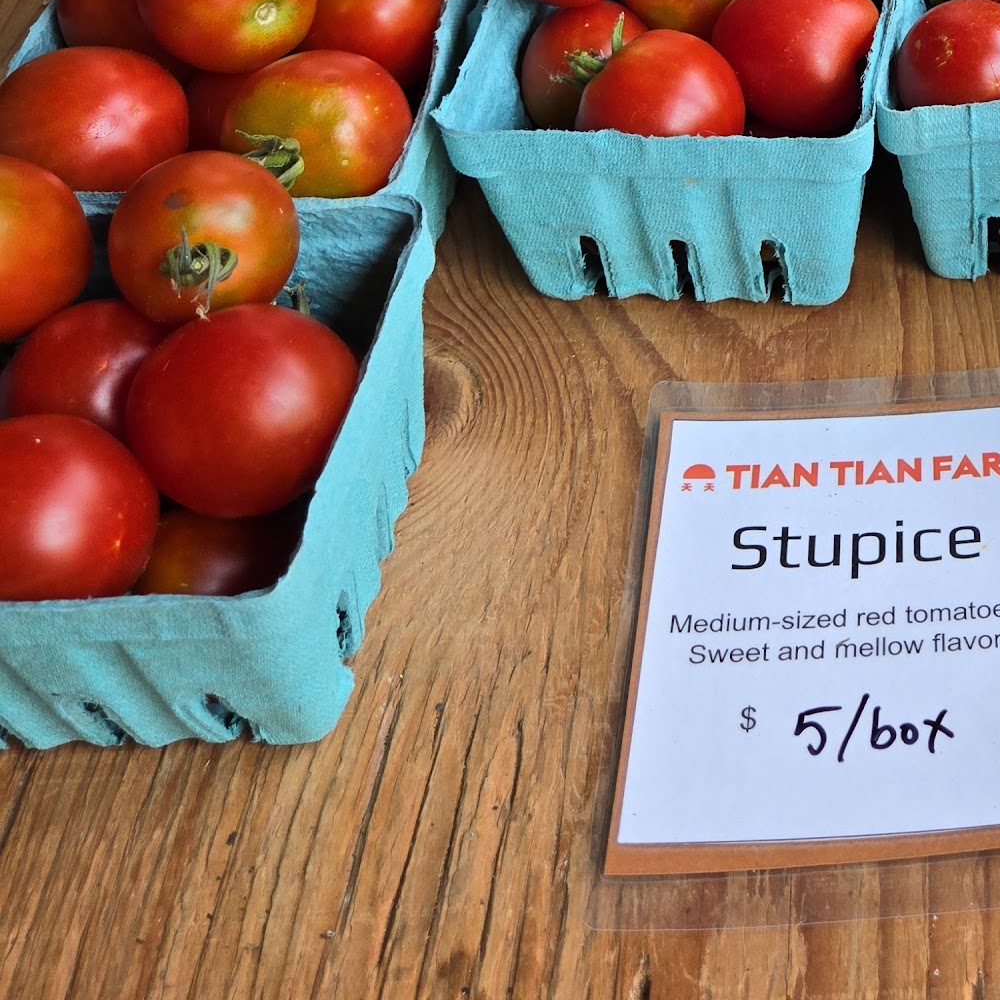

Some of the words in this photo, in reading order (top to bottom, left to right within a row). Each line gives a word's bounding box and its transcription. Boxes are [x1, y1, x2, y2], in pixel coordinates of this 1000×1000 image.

[725, 461, 819, 491] TIAN
[829, 457, 922, 487] TIAN
[731, 520, 983, 580] Stupice
[669, 609, 847, 635] Medium-sized
[857, 604, 896, 627] red
[688, 642, 770, 665] Sweet
[777, 639, 825, 661] and
[835, 636, 924, 659] mellow
[739, 705, 758, 733] $
[794, 693, 954, 763] 5/box
